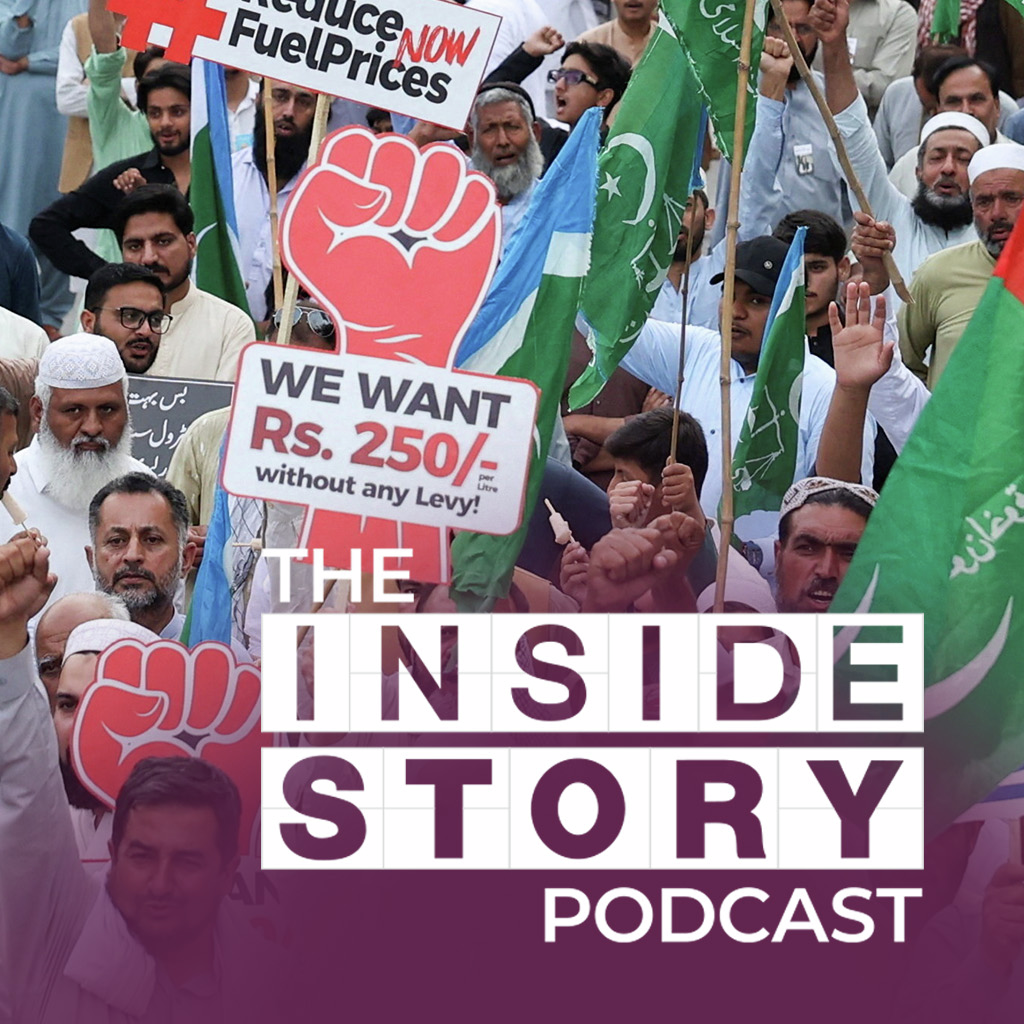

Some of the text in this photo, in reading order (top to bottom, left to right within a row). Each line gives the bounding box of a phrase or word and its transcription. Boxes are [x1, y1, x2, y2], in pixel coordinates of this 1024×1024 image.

[229, 8, 452, 105] FuelPrices
[393, 24, 480, 67] NOW
[261, 358, 511, 429] WE WANT
[250, 406, 498, 487] Rs. 250/-
[255, 464, 480, 517] without any Levy!
[478, 474, 494, 482] per
